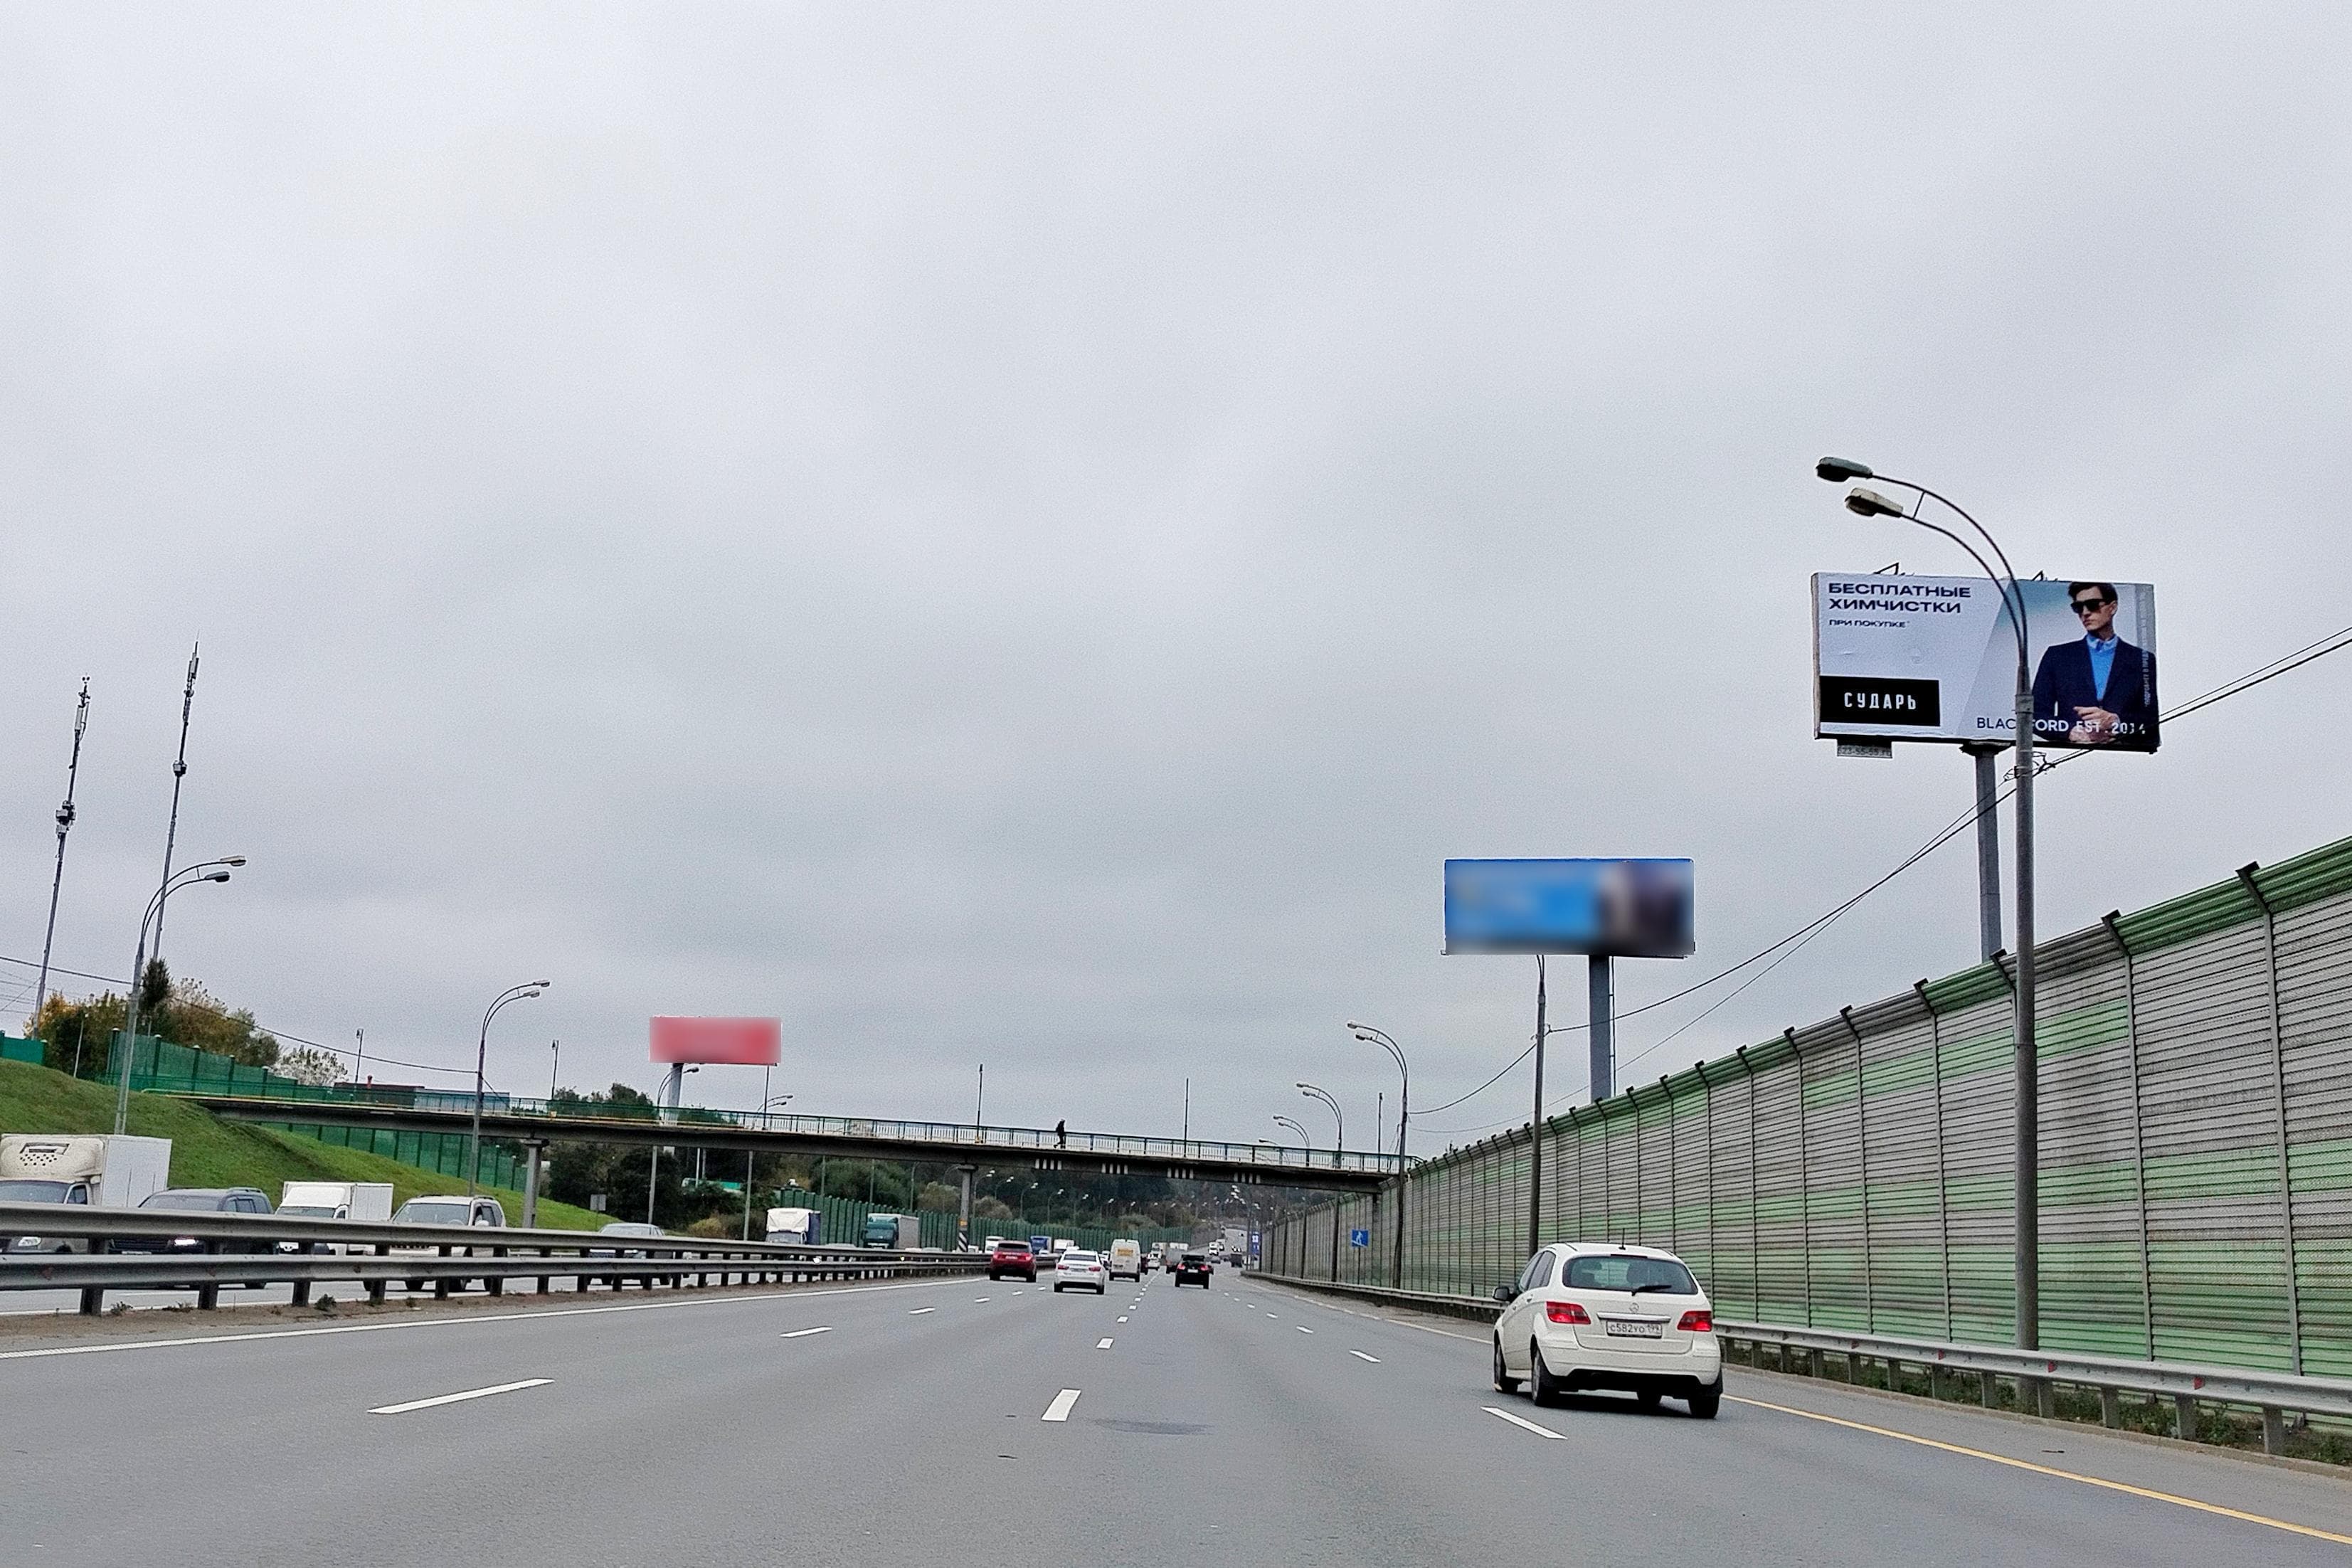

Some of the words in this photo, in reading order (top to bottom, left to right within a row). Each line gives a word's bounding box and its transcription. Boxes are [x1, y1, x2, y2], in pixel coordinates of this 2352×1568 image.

[1828, 583, 1971, 598] БЕСПЛАТНЫЕ
[1828, 598, 1961, 613] ХИМЧИСТКИ
[1844, 692, 1917, 710] СУДАРЬ
[1976, 716, 2070, 733] BLACORD
